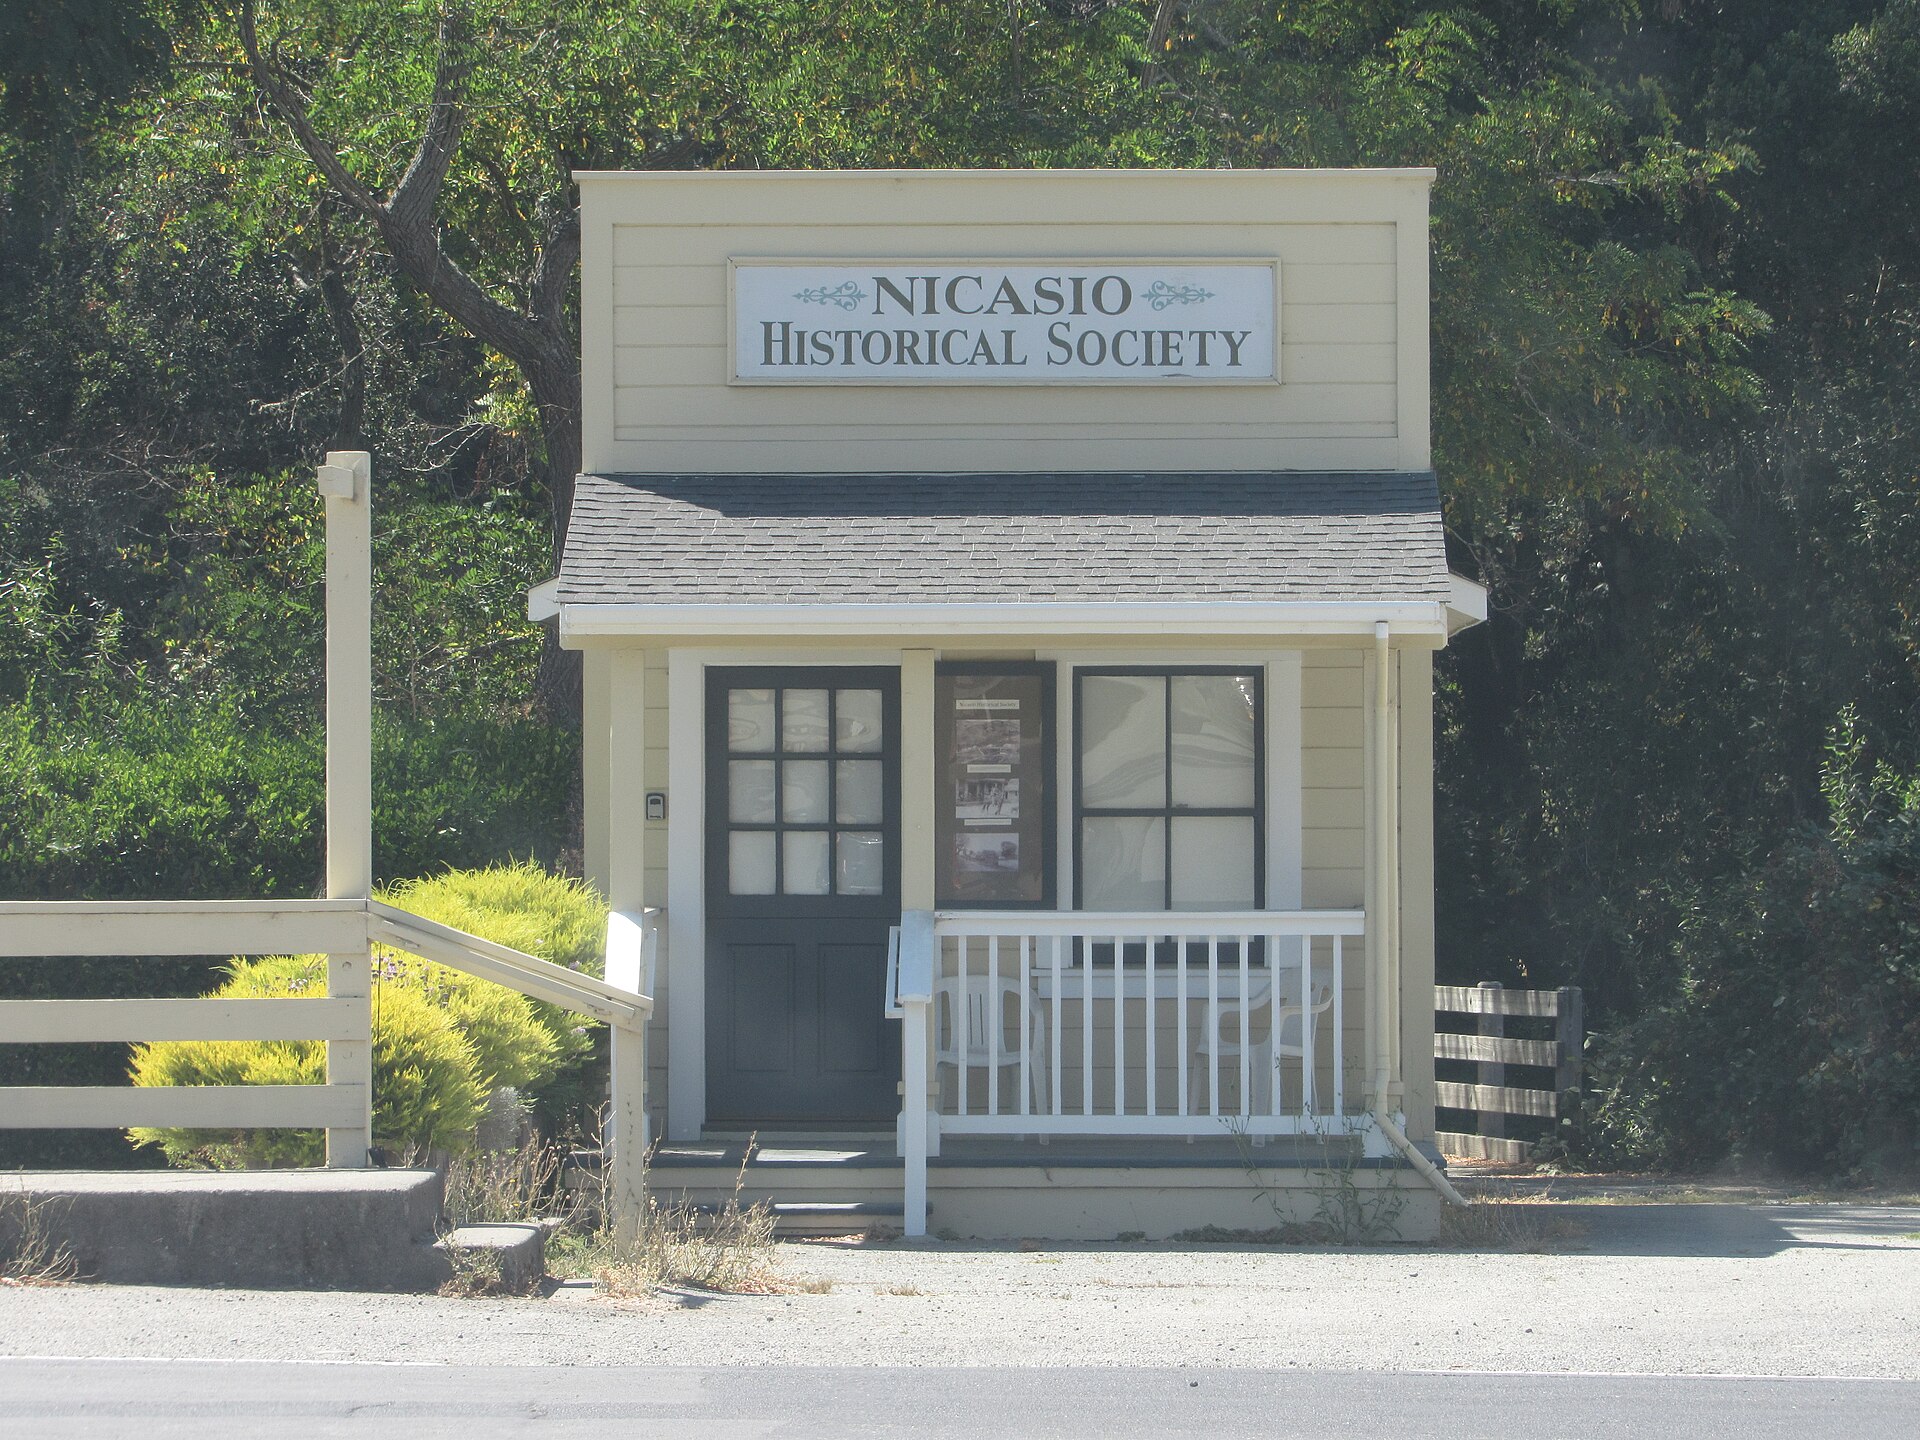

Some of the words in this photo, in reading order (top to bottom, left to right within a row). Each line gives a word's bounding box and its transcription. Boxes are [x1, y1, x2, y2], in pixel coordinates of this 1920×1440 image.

[872, 275, 1132, 316] NICASIO
[760, 321, 1028, 366] HISTORICAL
[1047, 321, 1252, 367] SOCIETY
